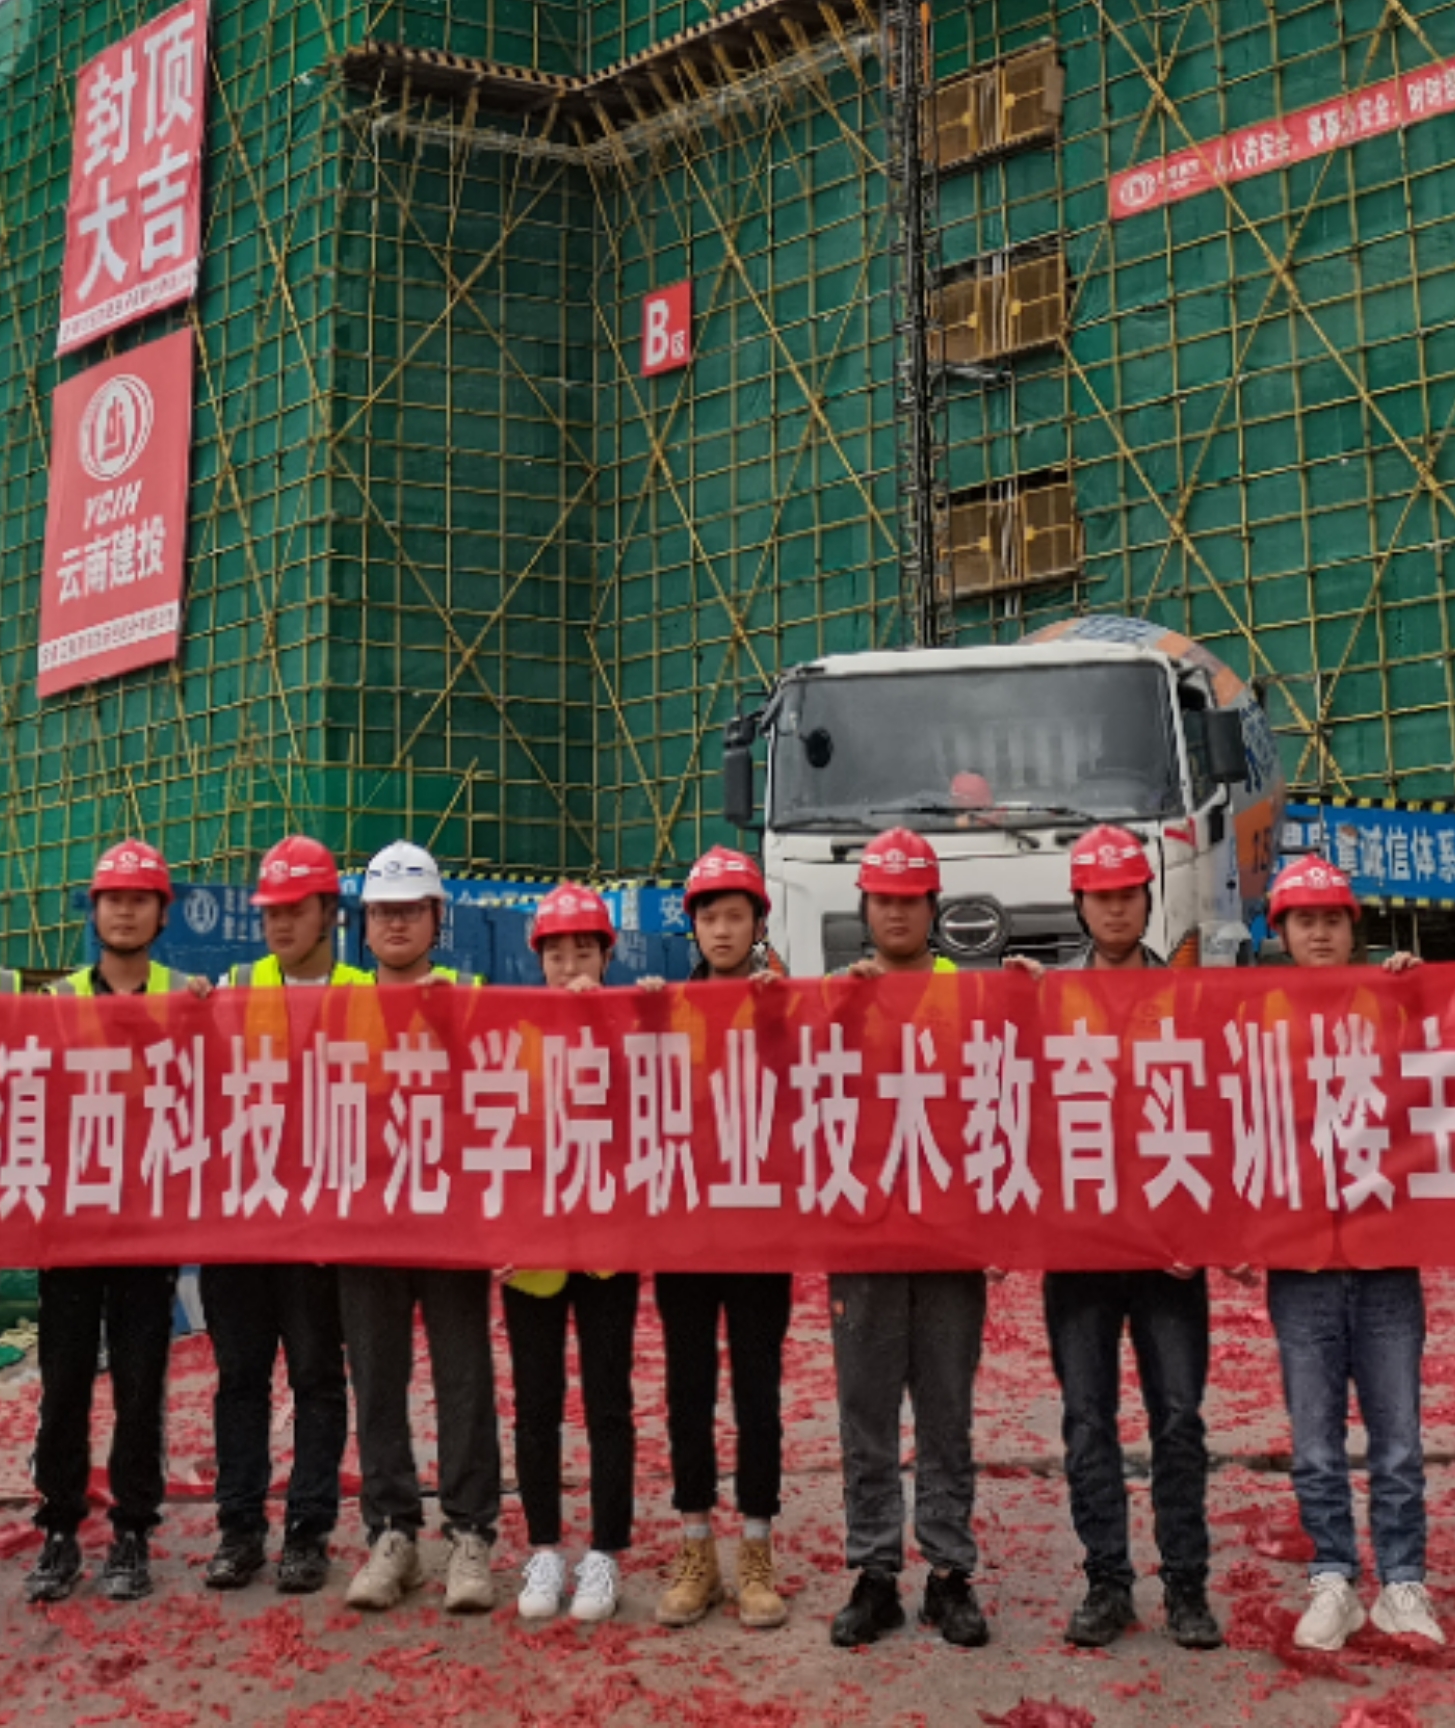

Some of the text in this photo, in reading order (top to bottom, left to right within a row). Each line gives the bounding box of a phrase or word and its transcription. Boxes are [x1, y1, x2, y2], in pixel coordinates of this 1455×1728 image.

[82, 10, 196, 176] 封顶
[76, 143, 189, 301] 大吉
[56, 514, 167, 605] 云南建投
